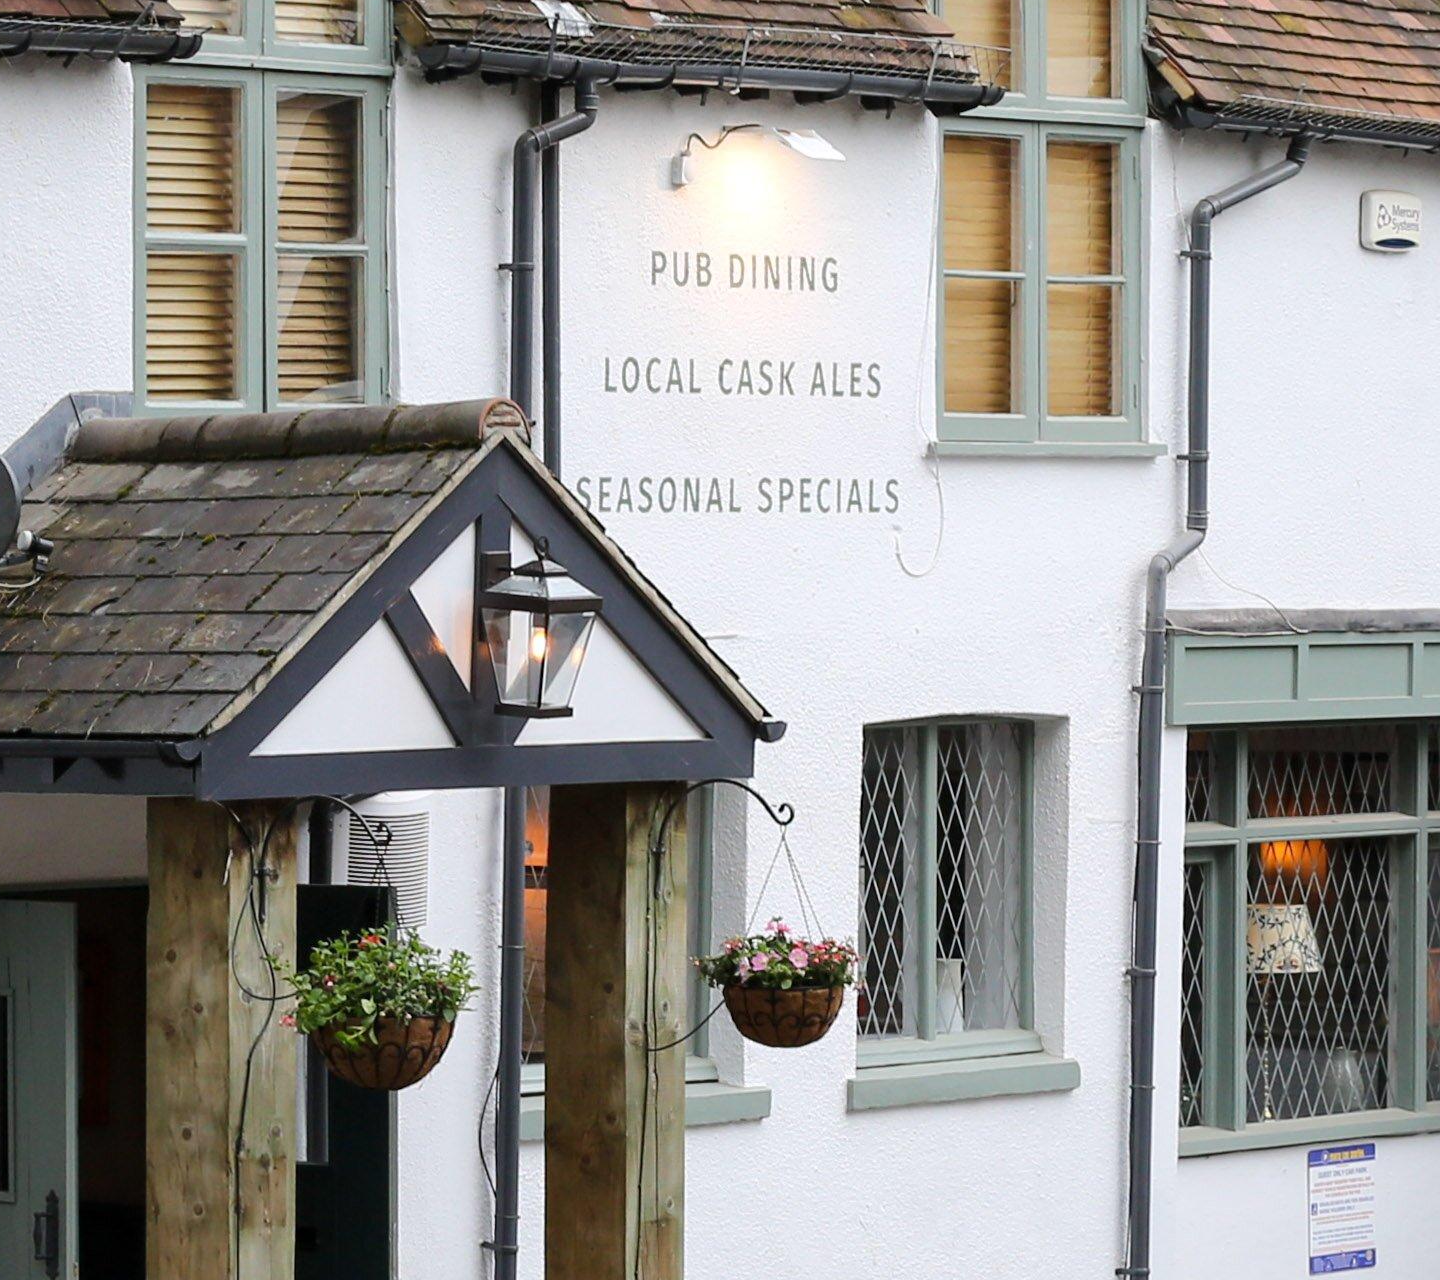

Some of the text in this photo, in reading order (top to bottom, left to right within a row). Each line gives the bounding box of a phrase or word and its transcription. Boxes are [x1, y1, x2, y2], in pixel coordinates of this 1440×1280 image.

[1392, 204, 1420, 222] Mercury
[1392, 218, 1420, 234] Systems
[651, 251, 839, 293] PUB DINING
[605, 357, 882, 398] LOCAL CASK ALES
[576, 476, 899, 515] SEASONAL SPECIALS
